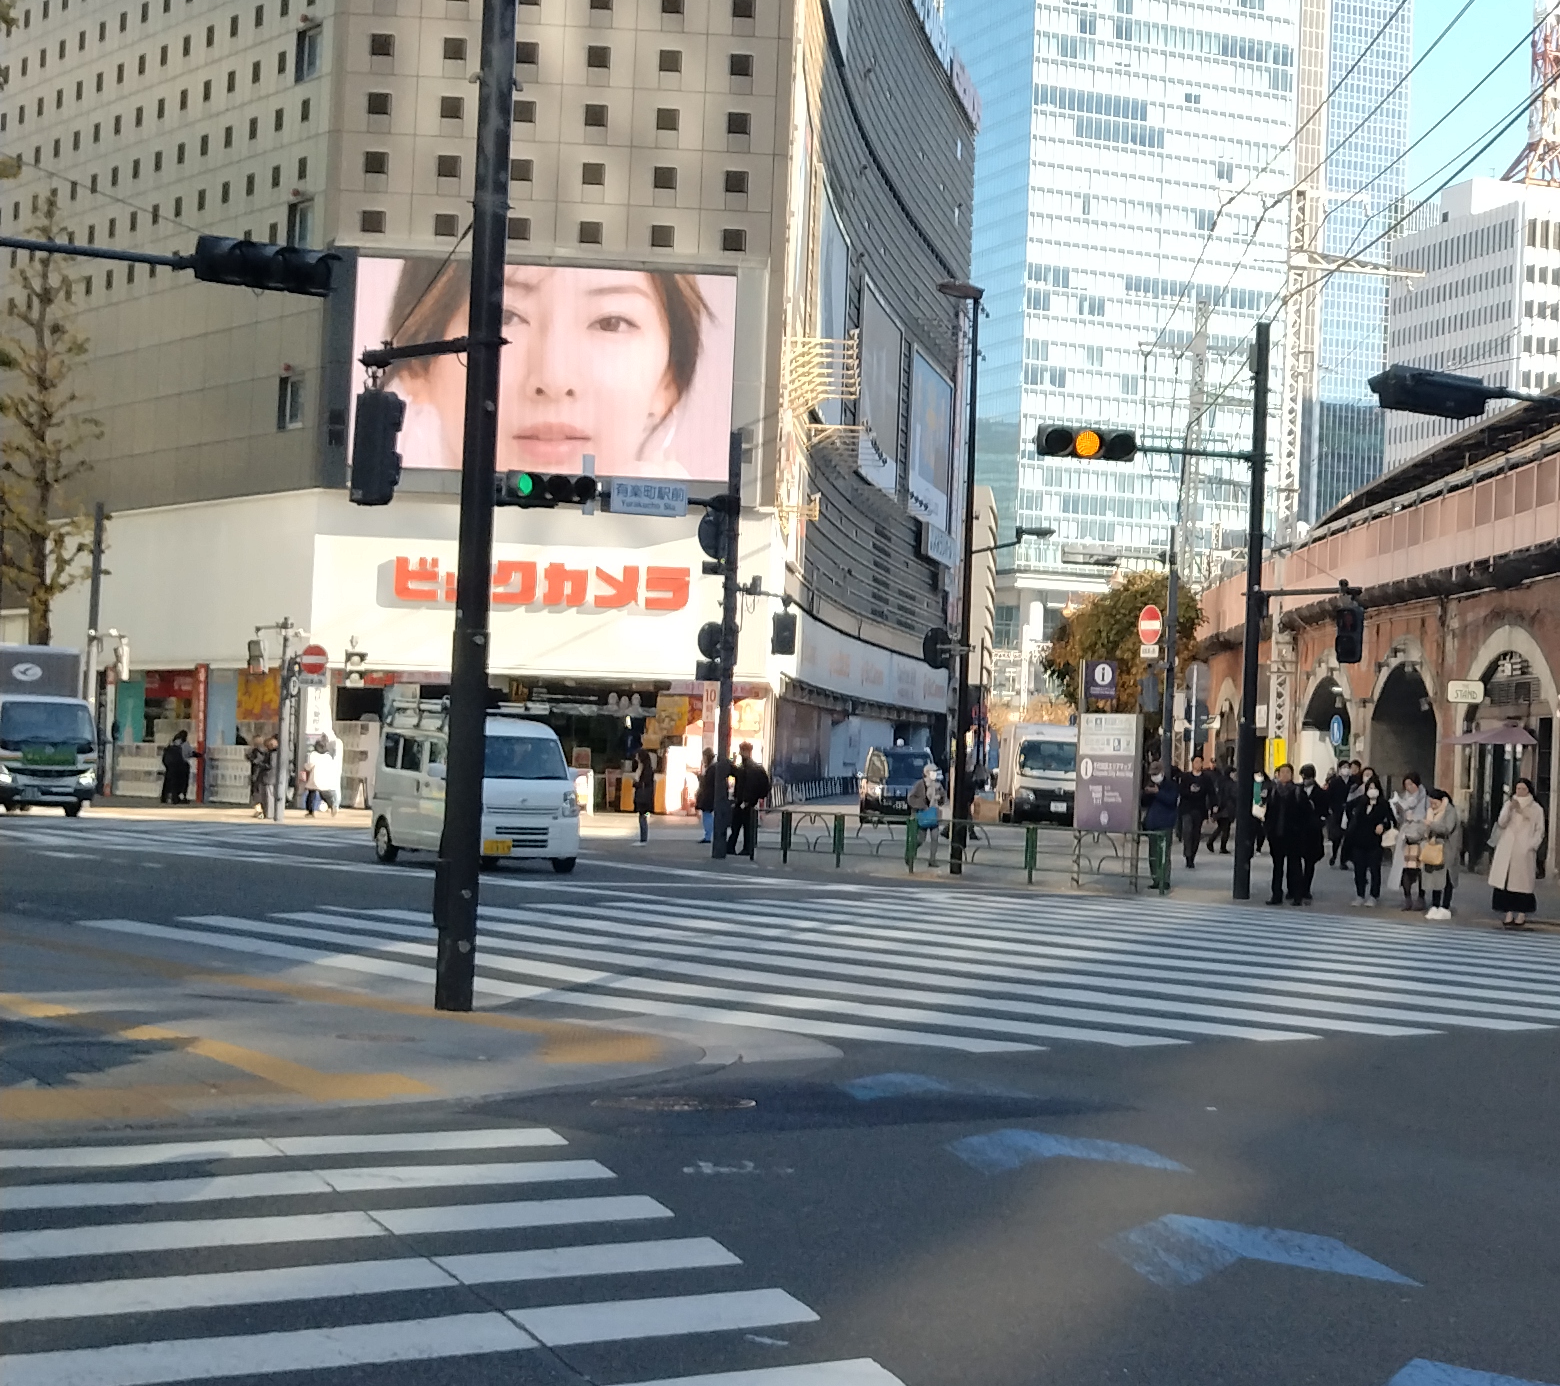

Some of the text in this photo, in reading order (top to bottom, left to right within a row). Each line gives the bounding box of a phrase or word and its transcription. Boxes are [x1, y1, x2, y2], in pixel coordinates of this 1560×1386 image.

[616, 482, 685, 502] 有楽町駅前
[394, 556, 691, 610] ビクカメラ
[1454, 689, 1478, 700] STAND
